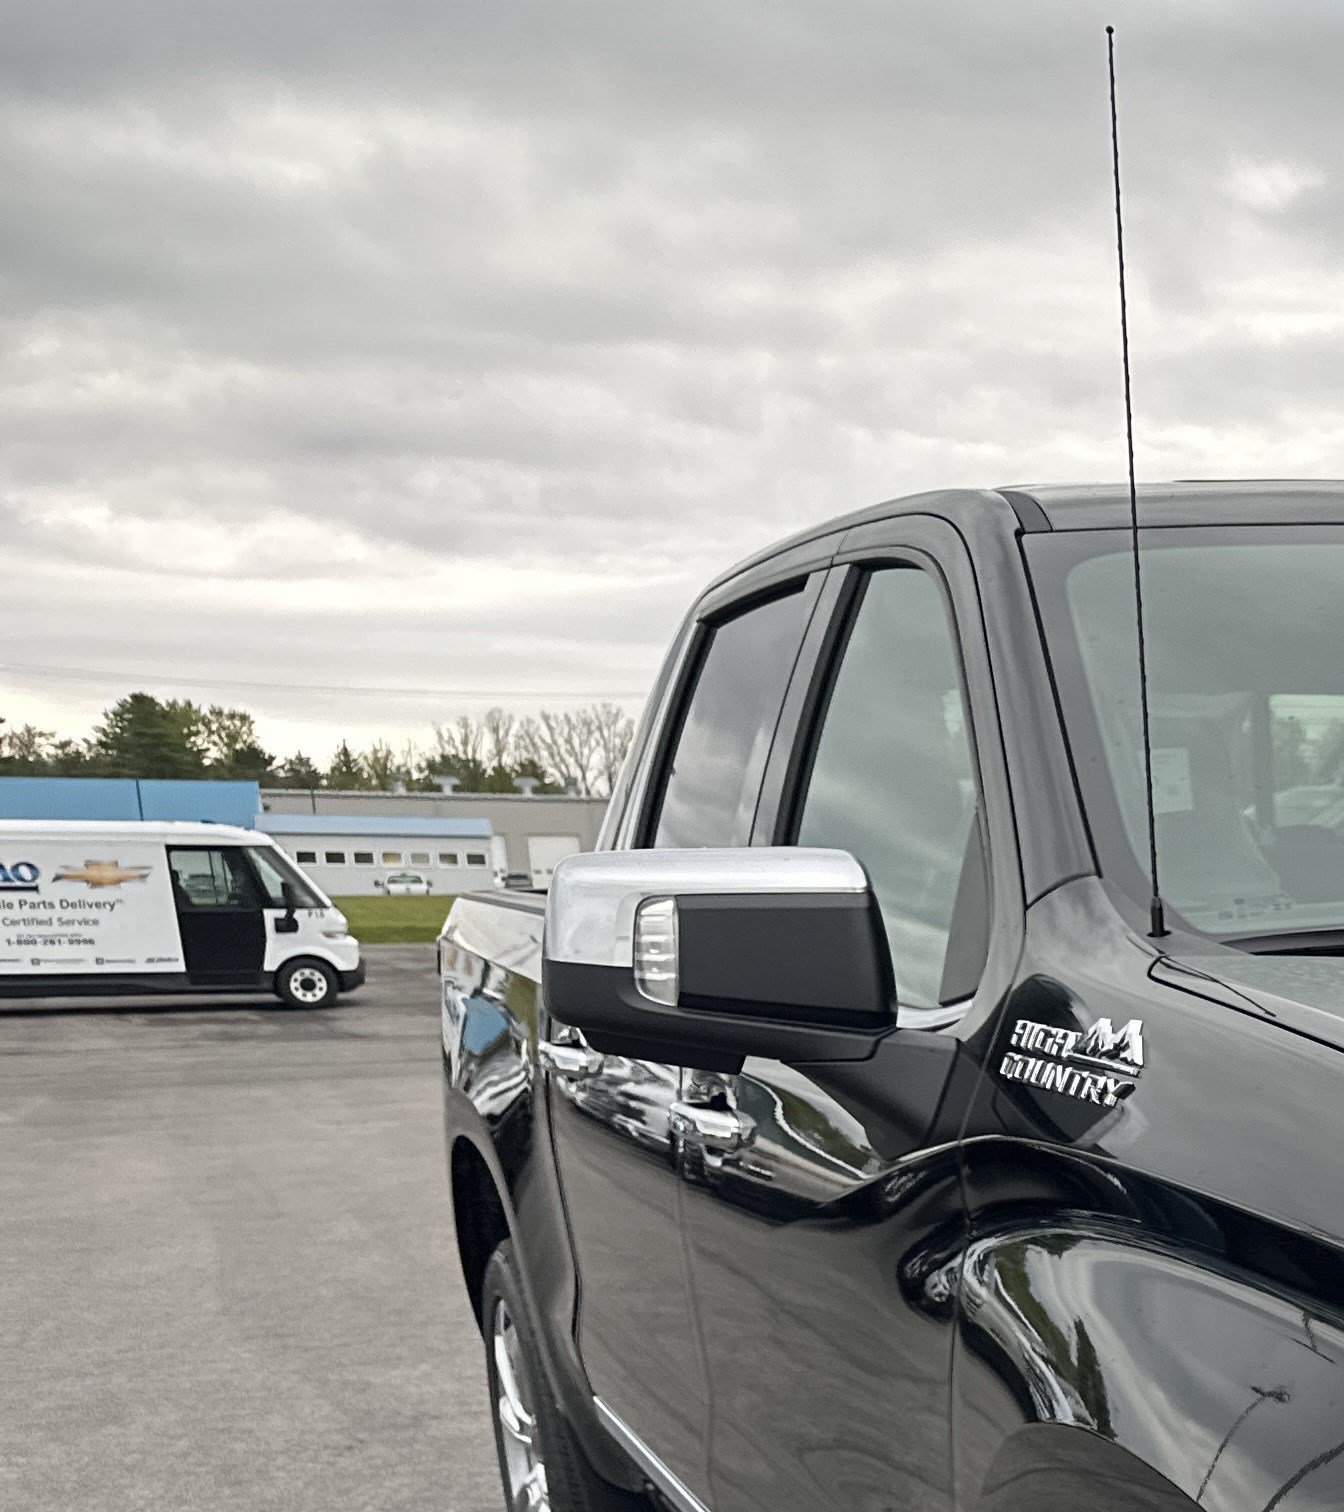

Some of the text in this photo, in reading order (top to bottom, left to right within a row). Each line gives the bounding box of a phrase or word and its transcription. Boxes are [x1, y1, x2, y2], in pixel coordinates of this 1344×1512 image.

[18, 899, 56, 910] Parts
[59, 898, 117, 912] Delivery
[2, 917, 99, 927] Certified Service
[999, 1051, 1136, 1107] COUNTRY
